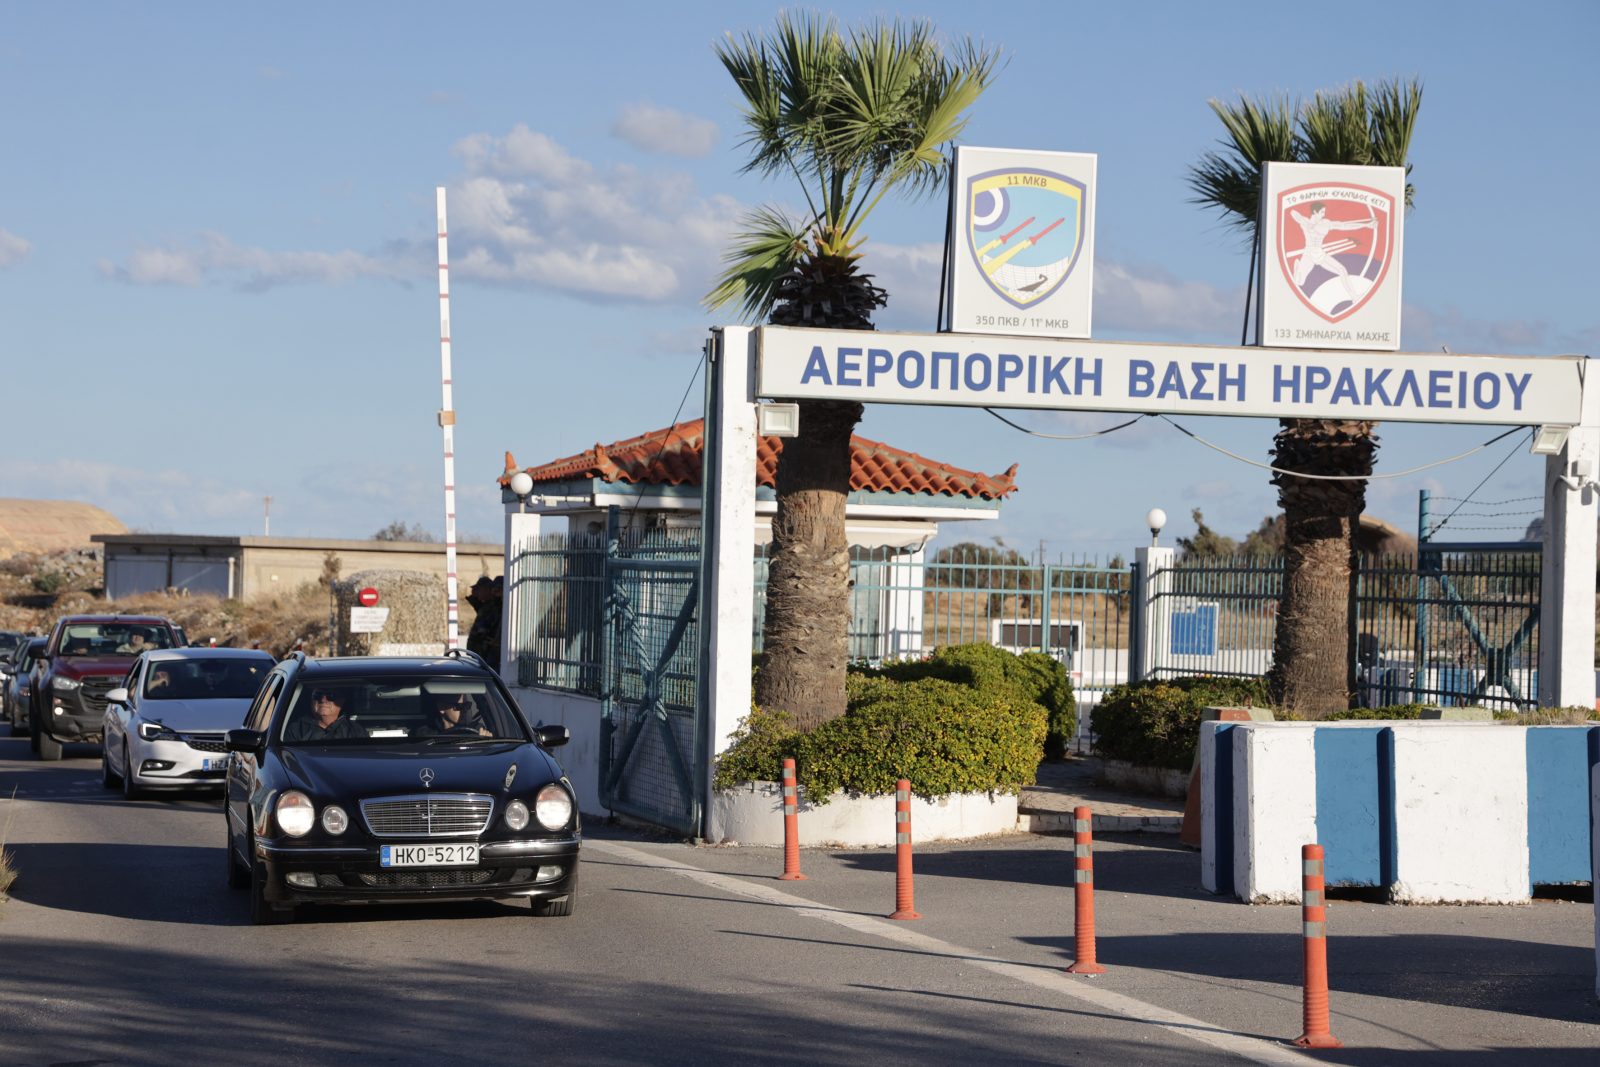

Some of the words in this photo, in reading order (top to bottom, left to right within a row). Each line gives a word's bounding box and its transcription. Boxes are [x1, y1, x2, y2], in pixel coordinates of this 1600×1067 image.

[1008, 176, 1020, 185] 11
[1023, 175, 1048, 187] ΜΚΒ
[976, 315, 995, 325] 350
[998, 316, 1021, 327] ΠΚΒ
[1045, 318, 1070, 328] ΜΚΒ
[1274, 329, 1291, 338] 133
[1296, 329, 1352, 340] ΣΜΗΝΑΡΧΙΑ
[1356, 332, 1391, 342] ΜΑΧΗΣ
[801, 347, 1102, 395] ΑΕΡΟΠΟΡΙΚΗ
[1130, 360, 1246, 401] ΒΑΣΗ
[1274, 366, 1532, 410] ΗΡΑΚΛΕΙΟΥ
